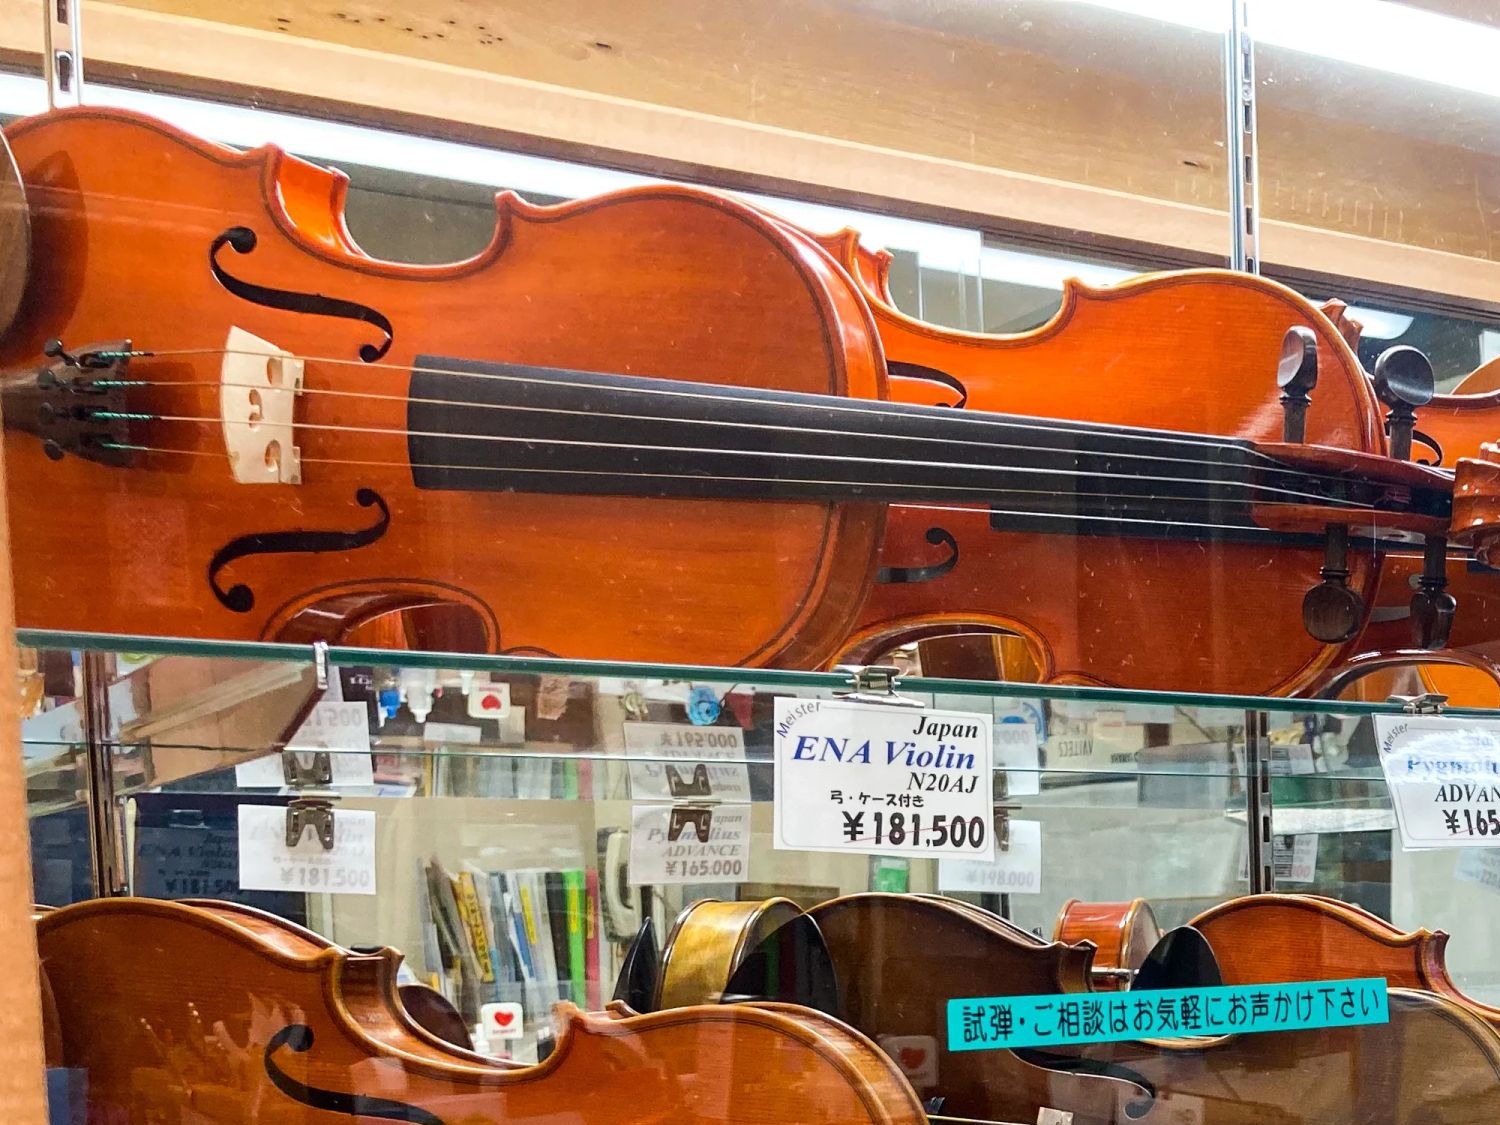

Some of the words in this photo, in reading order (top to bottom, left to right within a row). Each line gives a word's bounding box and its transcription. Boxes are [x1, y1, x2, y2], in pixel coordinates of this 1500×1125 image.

[776, 700, 822, 739] Meister
[913, 716, 979, 741] Japan
[792, 736, 871, 764] ENA
[886, 741, 976, 769] Violin
[830, 790, 925, 808] 弓・ケース付き
[907, 772, 979, 794] N20AJ
[842, 811, 985, 848] ¥181,500
[963, 986, 1380, 1043] 試弾・ご相談はお気軽にお声かけ下さい
